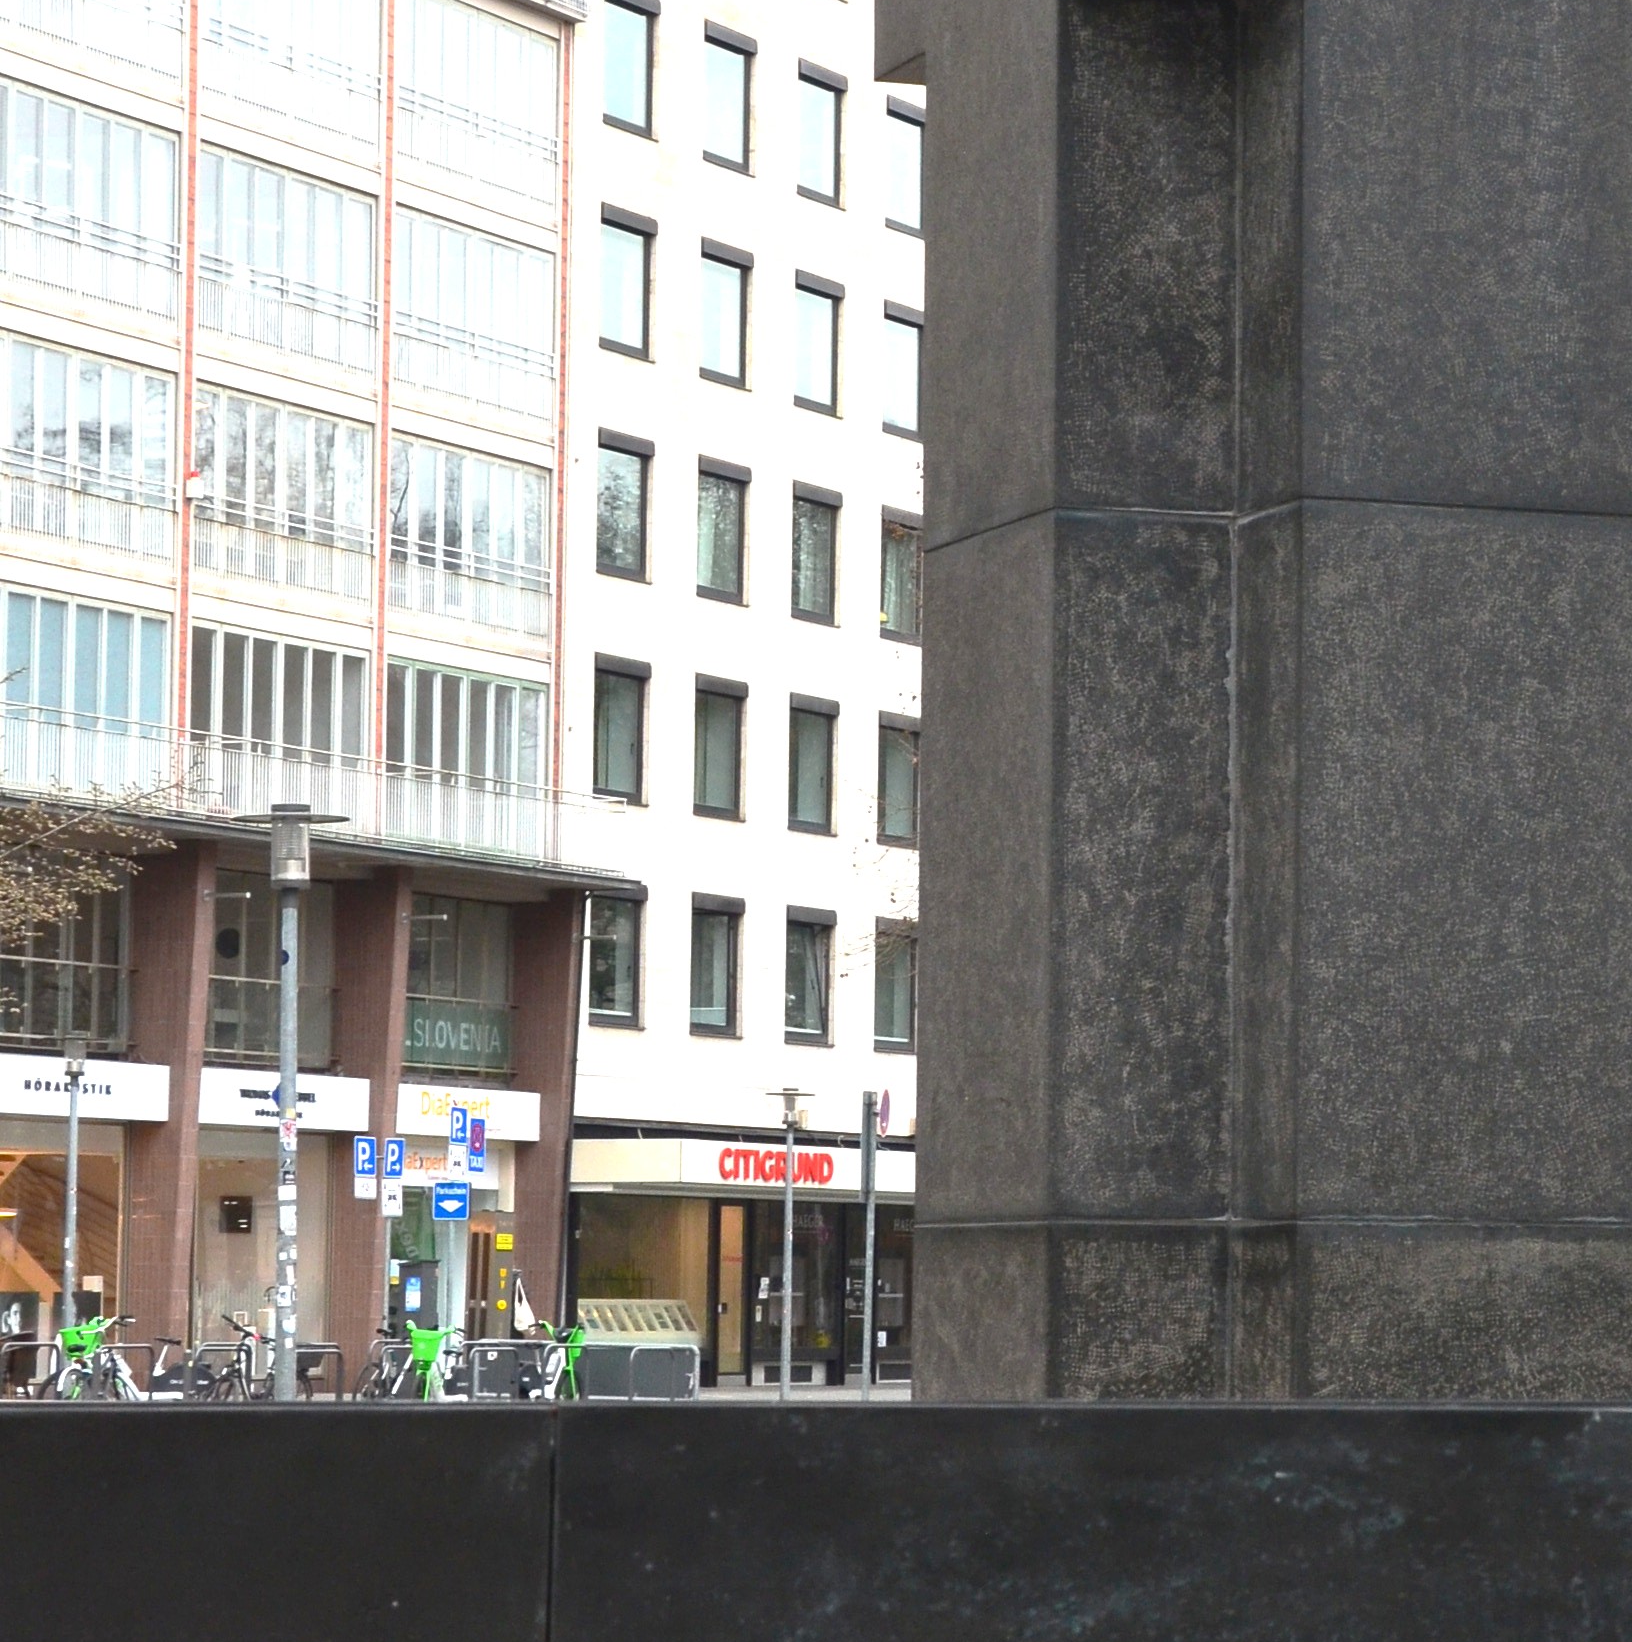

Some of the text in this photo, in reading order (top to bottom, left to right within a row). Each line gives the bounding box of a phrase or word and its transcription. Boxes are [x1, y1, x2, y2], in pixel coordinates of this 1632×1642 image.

[452, 1110, 463, 1139] P
[357, 1141, 370, 1171] P
[387, 1143, 399, 1172] P
[469, 1155, 483, 1169] TAXI
